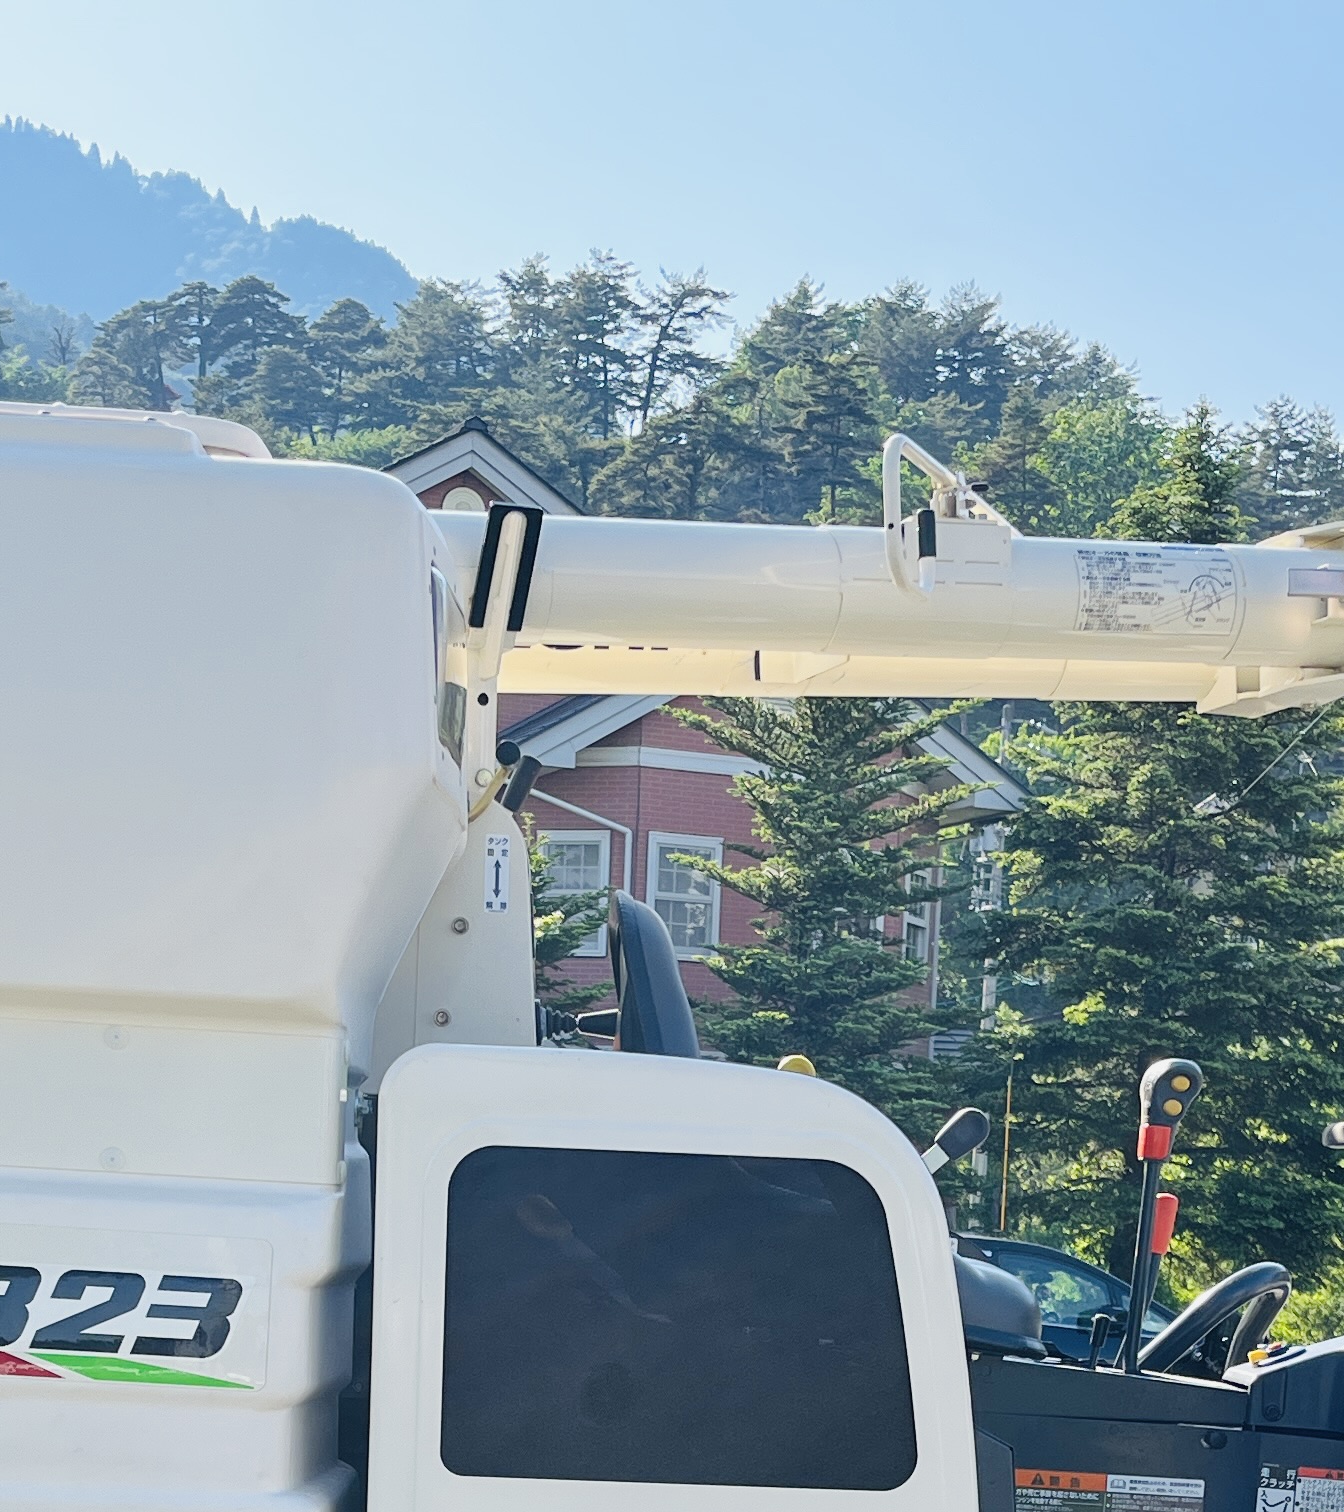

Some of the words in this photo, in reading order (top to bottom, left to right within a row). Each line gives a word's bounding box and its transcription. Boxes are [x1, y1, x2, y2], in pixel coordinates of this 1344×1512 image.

[488, 837, 508, 846] タンク
[1260, 1478, 1295, 1489] クラッチ
